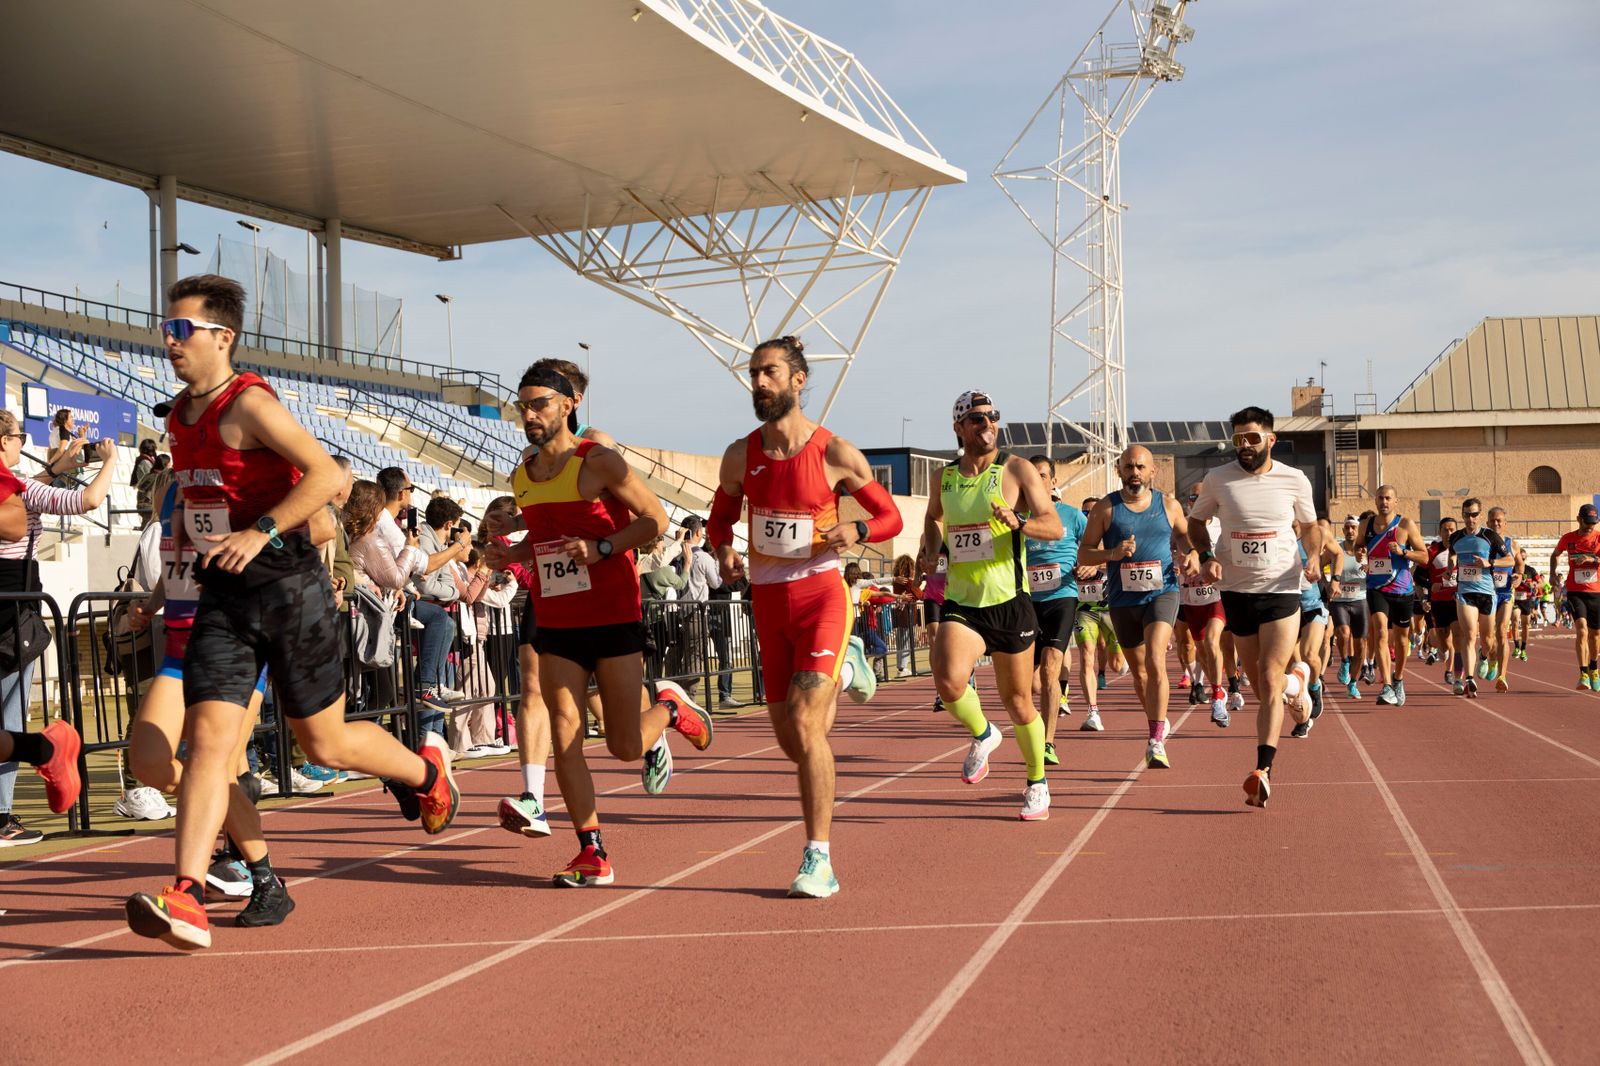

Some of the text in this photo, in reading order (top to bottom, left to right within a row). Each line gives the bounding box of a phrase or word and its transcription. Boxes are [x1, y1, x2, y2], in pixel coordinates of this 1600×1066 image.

[64, 406, 100, 424] RNANDO
[194, 513, 213, 532] 55
[765, 520, 797, 540] 571
[955, 533, 981, 548] 278
[1241, 541, 1267, 554] 621
[543, 559, 579, 579] 784
[1374, 560, 1385, 568] 29
[1032, 570, 1053, 582] 319
[1130, 569, 1153, 581] 575
[1080, 585, 1097, 594] 418
[1195, 587, 1213, 596] 660
